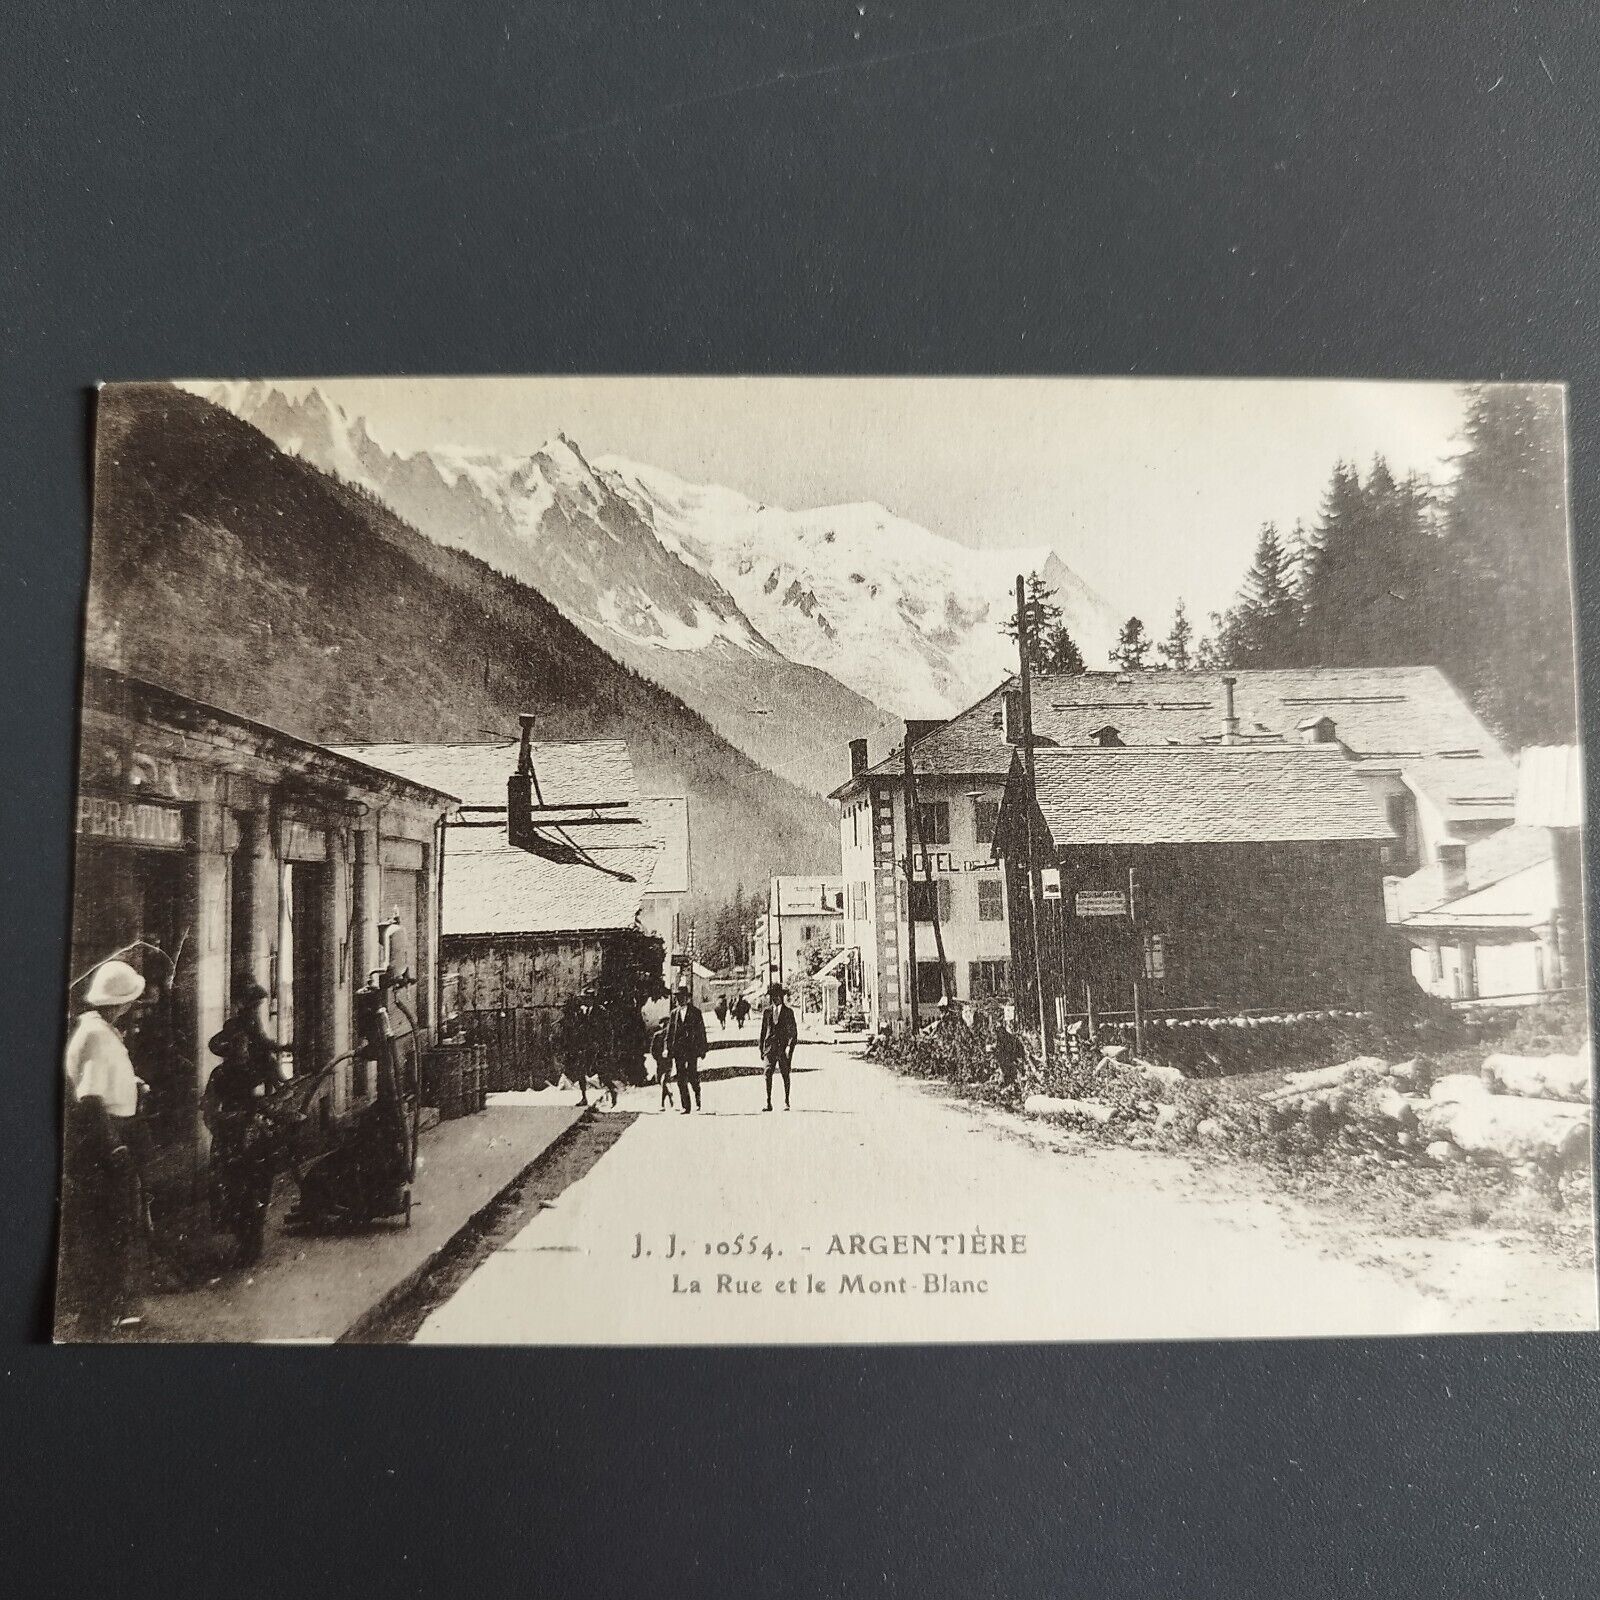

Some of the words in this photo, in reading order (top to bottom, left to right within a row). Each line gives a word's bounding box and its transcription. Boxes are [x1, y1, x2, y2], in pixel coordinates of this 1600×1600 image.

[902, 852, 960, 872] OTEL
[631, 1231, 652, 1259] J.
[665, 1231, 687, 1259] J.
[704, 1232, 783, 1261] 10554.
[825, 1224, 1027, 1255] ARGENTIÈRE
[671, 1273, 701, 1294] La
[716, 1273, 763, 1294] Rue
[774, 1276, 798, 1294] et
[806, 1273, 826, 1294] le
